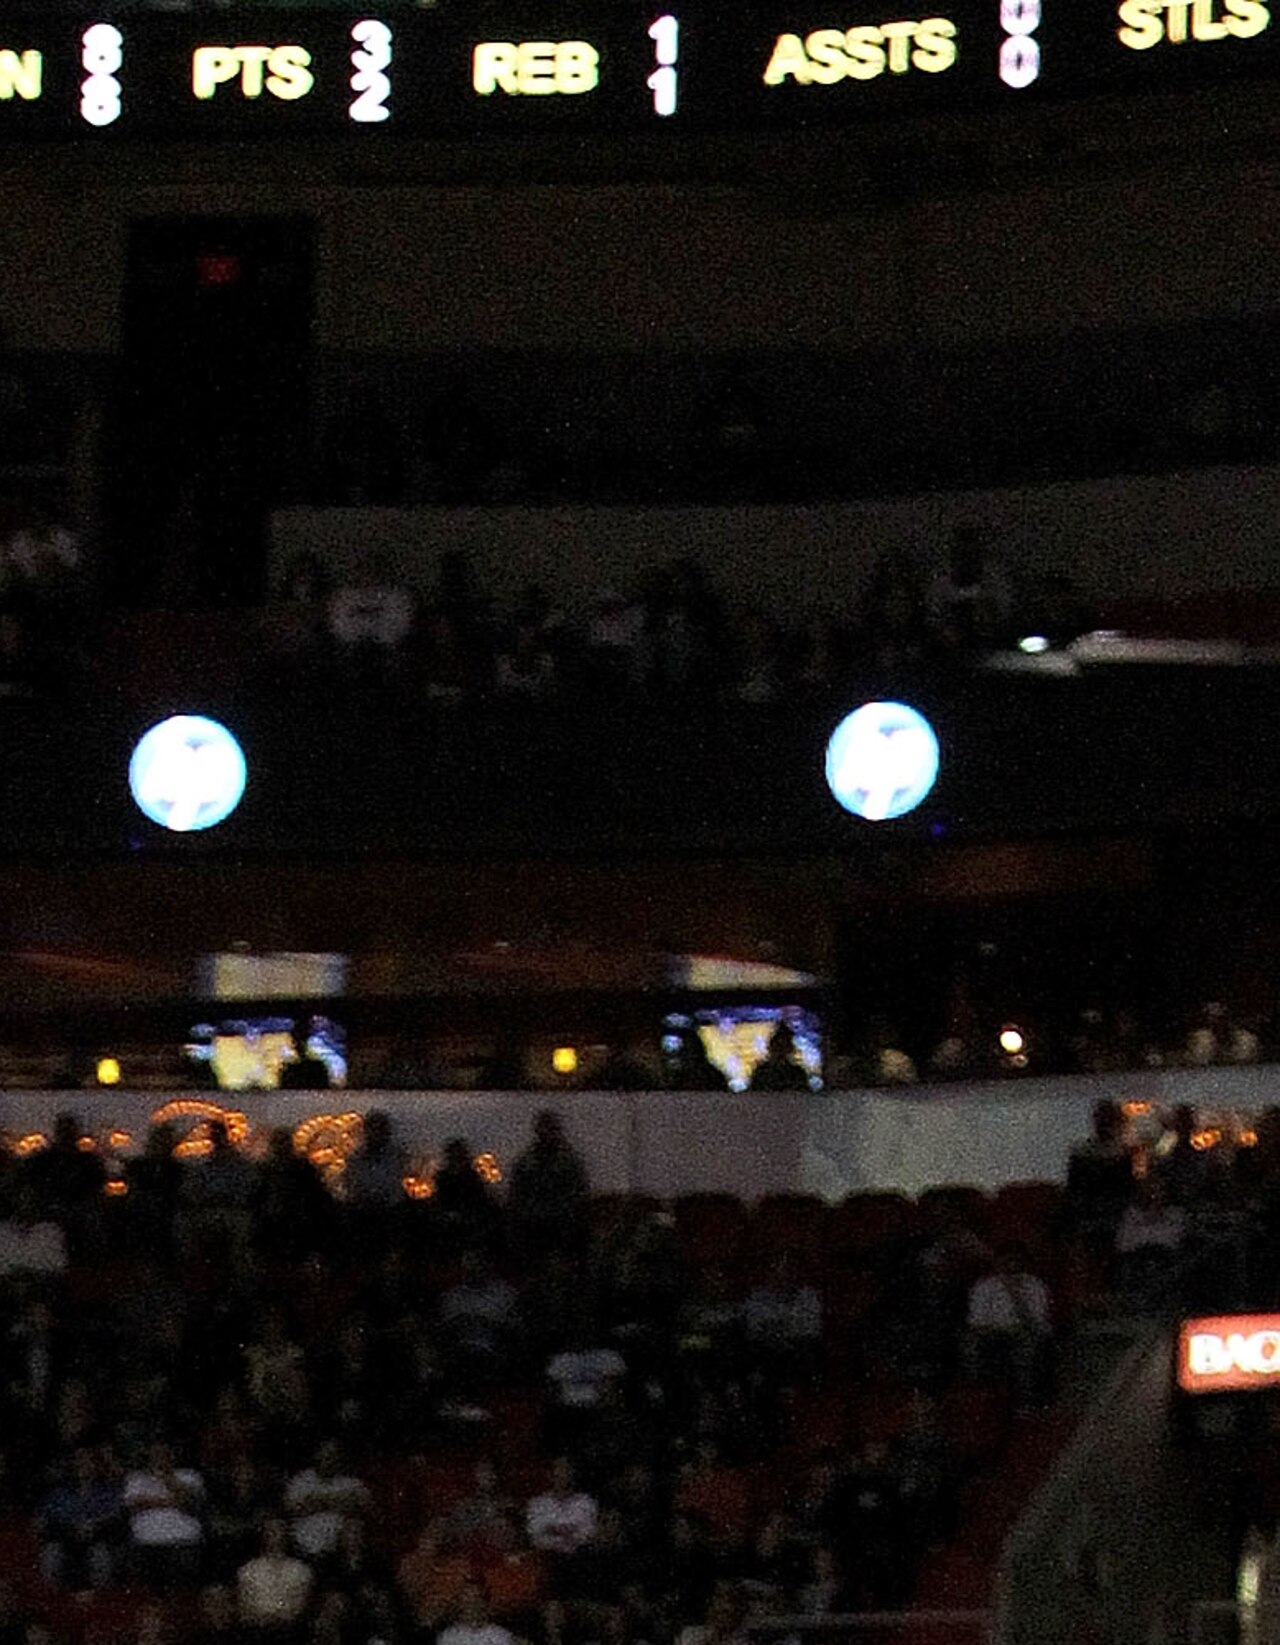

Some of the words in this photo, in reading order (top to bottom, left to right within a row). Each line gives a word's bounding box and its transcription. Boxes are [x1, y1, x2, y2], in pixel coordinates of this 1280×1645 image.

[350, 20, 393, 72] 3
[646, 15, 679, 65] 1
[762, 17, 957, 85] ASSTS
[1118, 0, 1271, 50] STLS
[192, 45, 314, 100] PTS
[472, 41, 600, 96] REB
[646, 64, 679, 116] 1
[348, 70, 392, 123] 2
[1189, 1330, 1280, 1374] BAC
